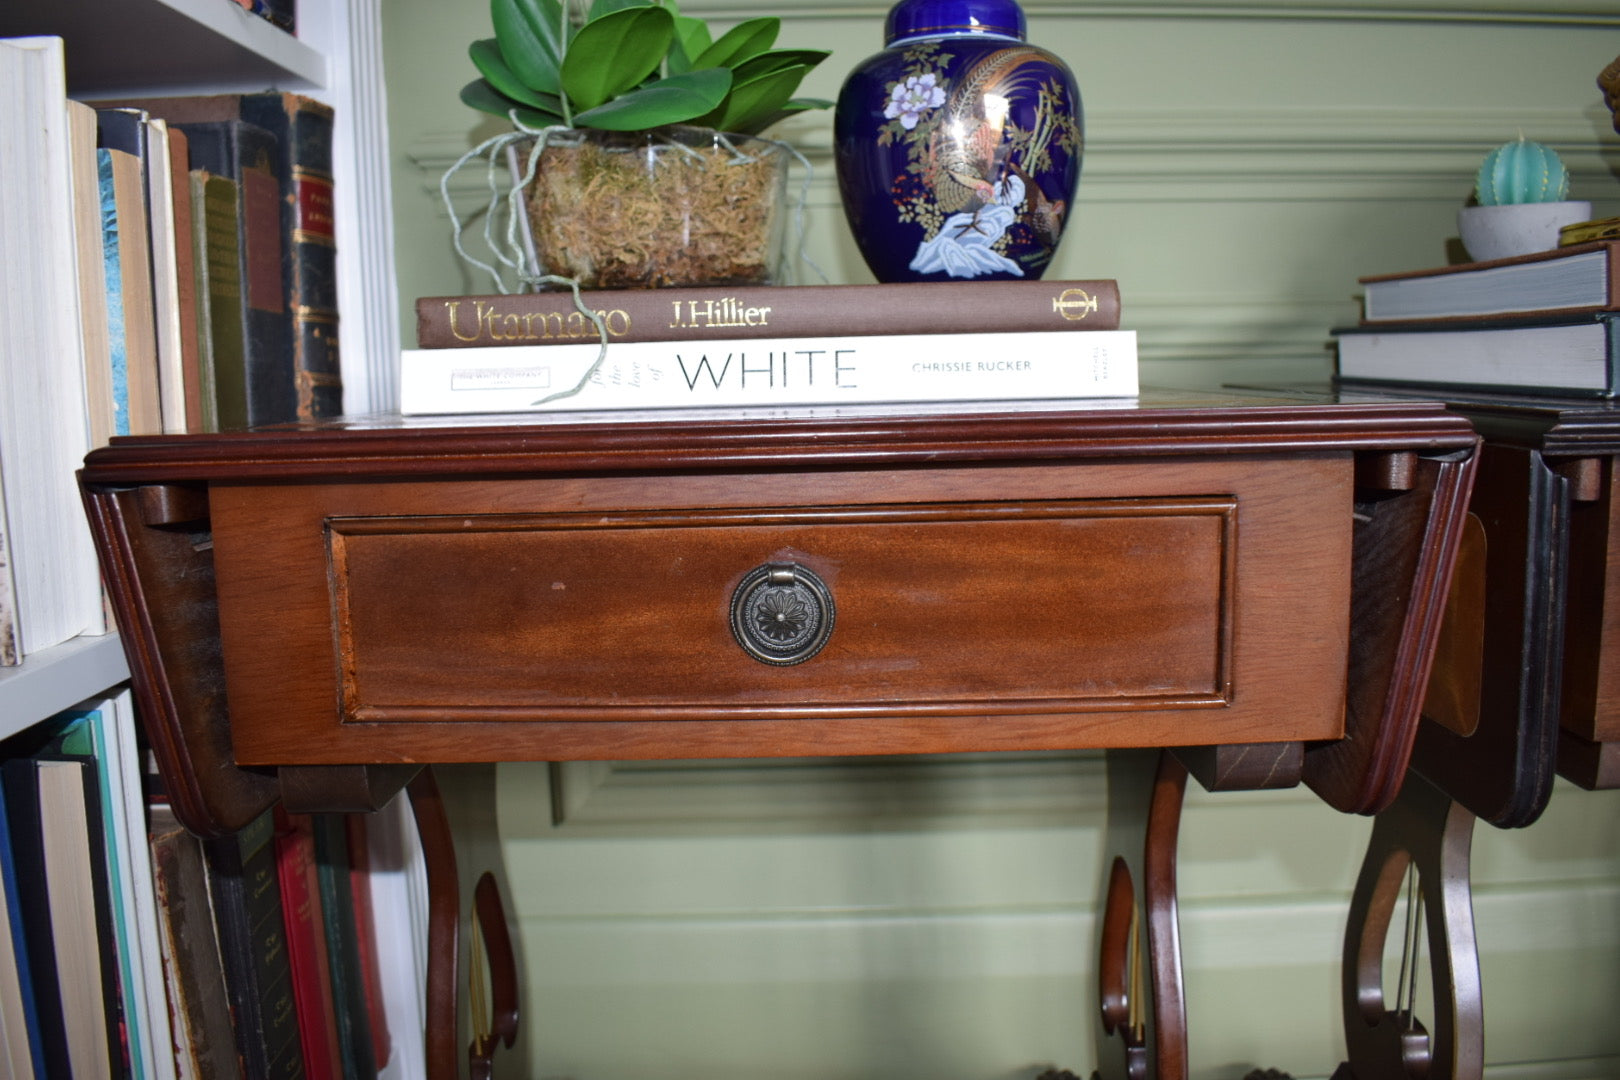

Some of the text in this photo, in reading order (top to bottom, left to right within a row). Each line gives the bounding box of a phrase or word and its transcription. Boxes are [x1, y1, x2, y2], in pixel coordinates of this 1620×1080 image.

[444, 300, 632, 341] Utamaro
[669, 297, 772, 329] J.Hillier
[606, 364, 622, 385] the
[627, 361, 641, 388] love
[647, 363, 664, 381] of
[676, 350, 858, 391] WHITE
[912, 360, 1032, 373] CHRISSIE RUCKER
